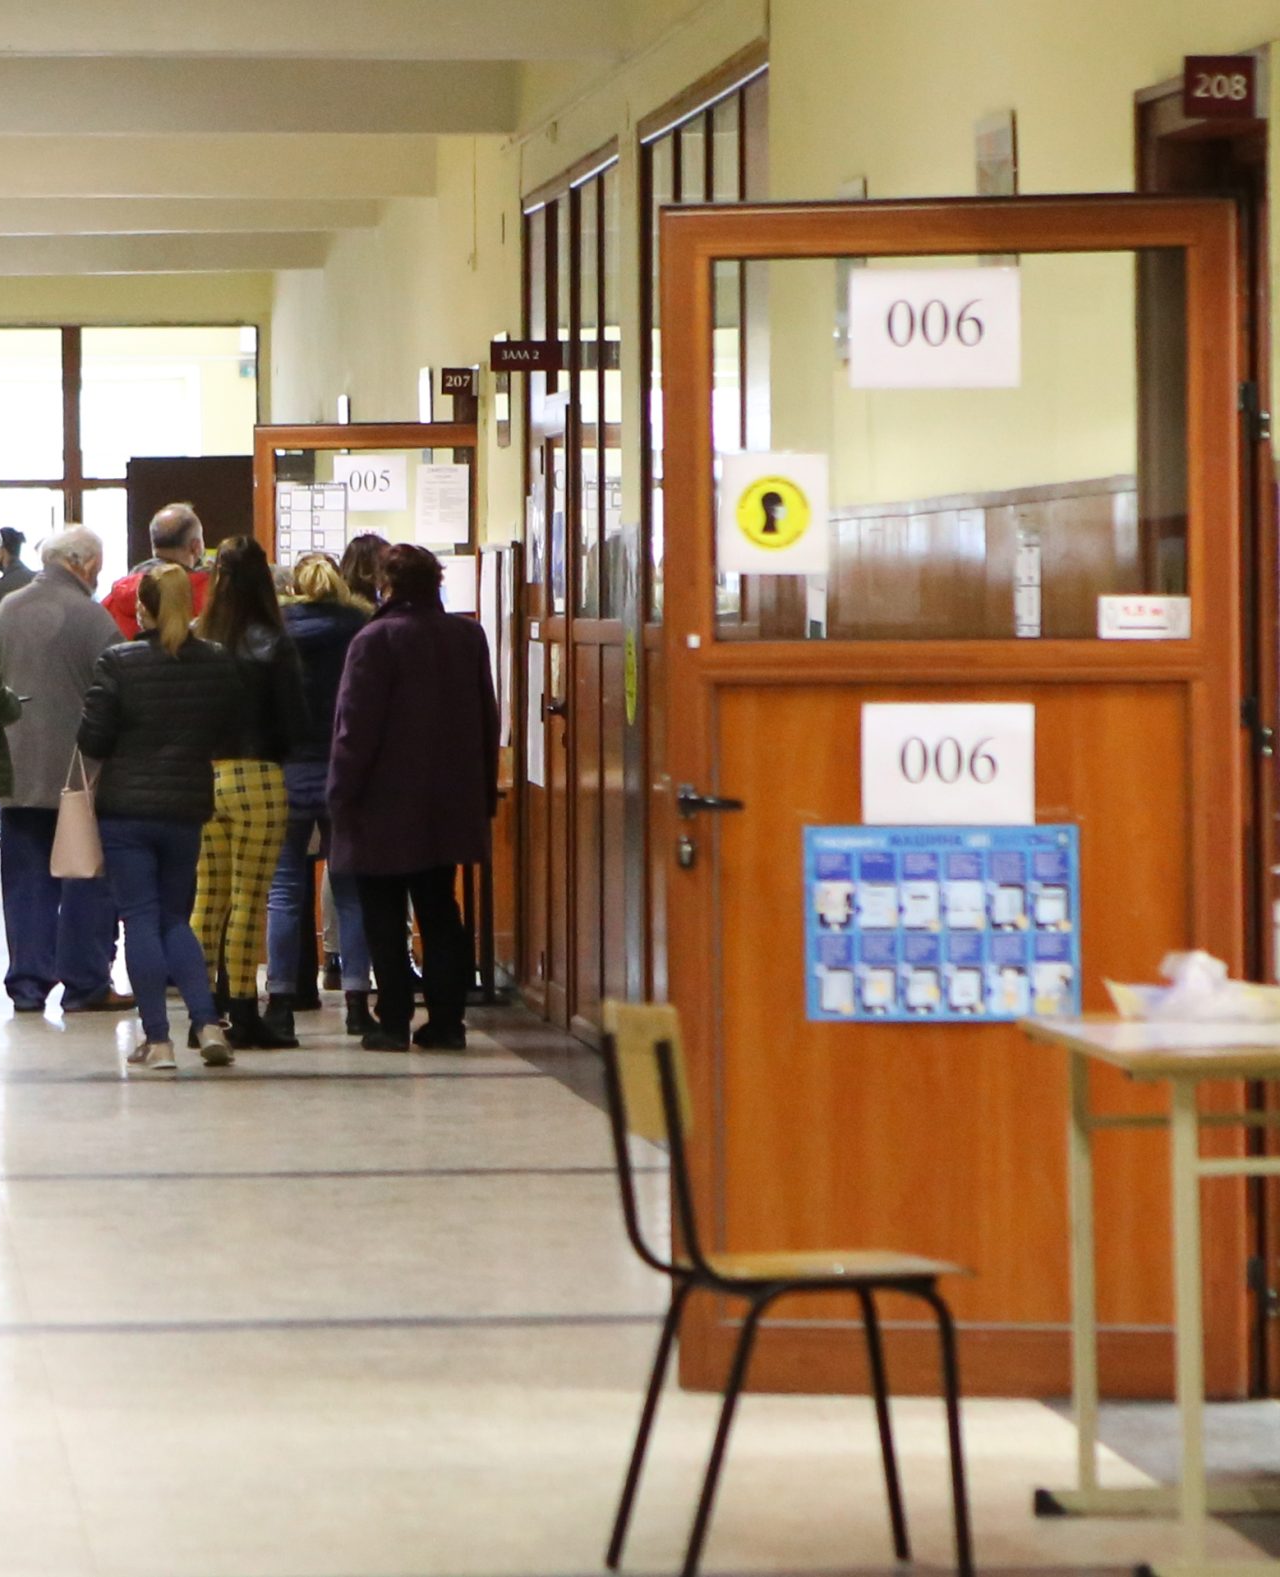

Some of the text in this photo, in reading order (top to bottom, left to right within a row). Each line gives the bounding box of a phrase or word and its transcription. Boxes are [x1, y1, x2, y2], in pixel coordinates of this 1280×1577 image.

[1193, 73, 1247, 100] 208
[887, 299, 984, 347] 006
[501, 350, 540, 360] ЗАЛА 2
[445, 375, 471, 387] 207
[349, 469, 391, 492] 005
[900, 736, 998, 784] 006
